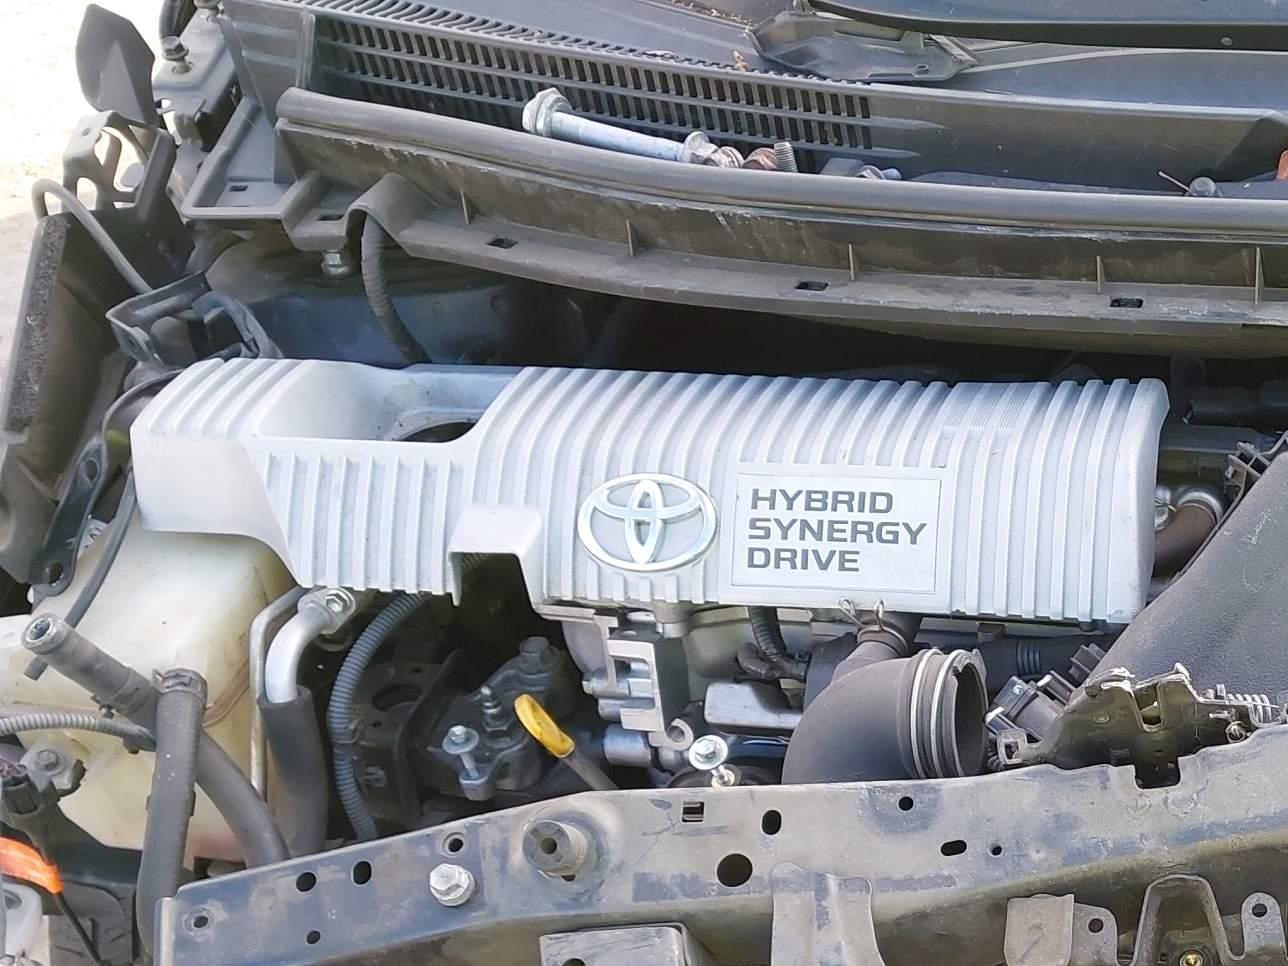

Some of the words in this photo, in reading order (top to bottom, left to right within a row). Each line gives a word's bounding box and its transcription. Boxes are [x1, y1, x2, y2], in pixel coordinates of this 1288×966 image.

[750, 488, 894, 514] HYBRID
[748, 517, 928, 545] SYNERGY
[747, 547, 860, 572] DRIVE
